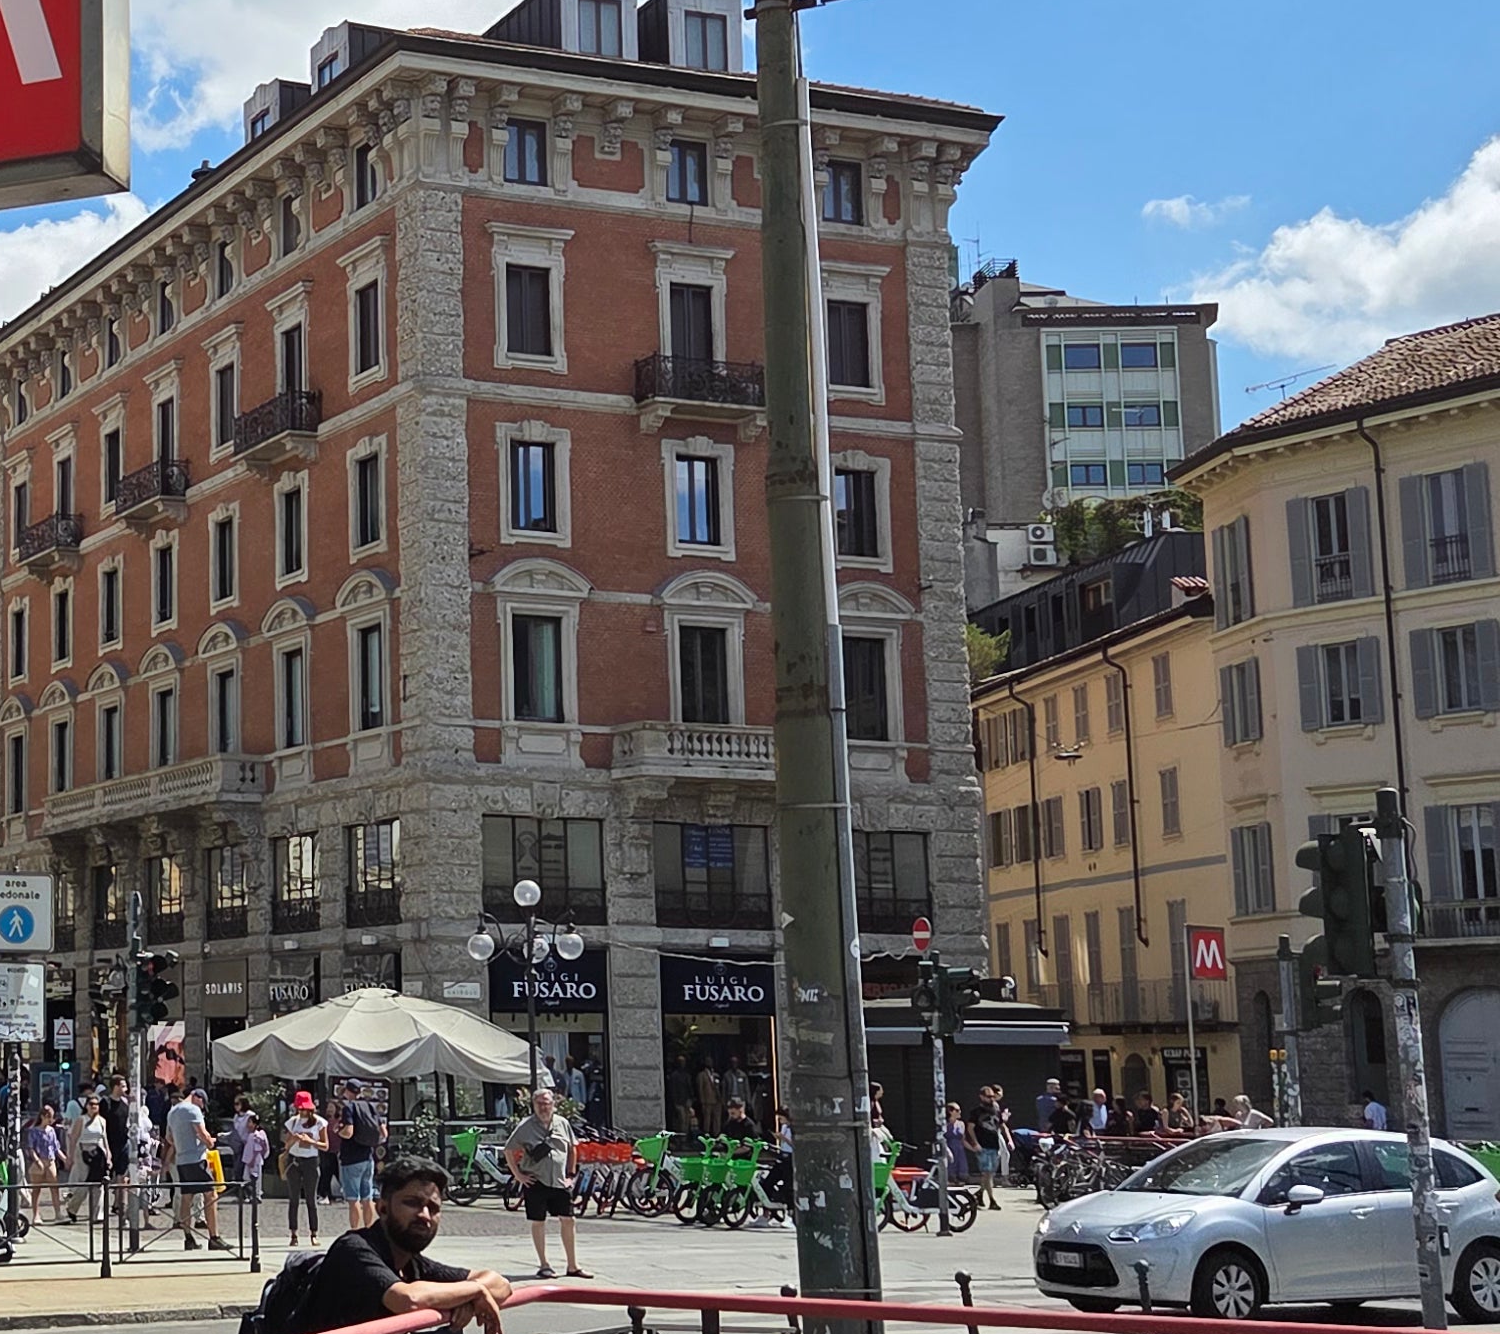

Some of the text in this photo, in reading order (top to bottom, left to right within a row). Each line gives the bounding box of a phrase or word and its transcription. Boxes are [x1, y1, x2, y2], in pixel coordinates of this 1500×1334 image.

[5, 879, 28, 888] area
[1194, 938, 1223, 970] M
[694, 975, 748, 985] LUIGI
[205, 982, 243, 995] SOLARIS
[269, 985, 309, 1001] FUSARO
[512, 981, 597, 999] FUSARO
[683, 985, 765, 1002] FUSARO
